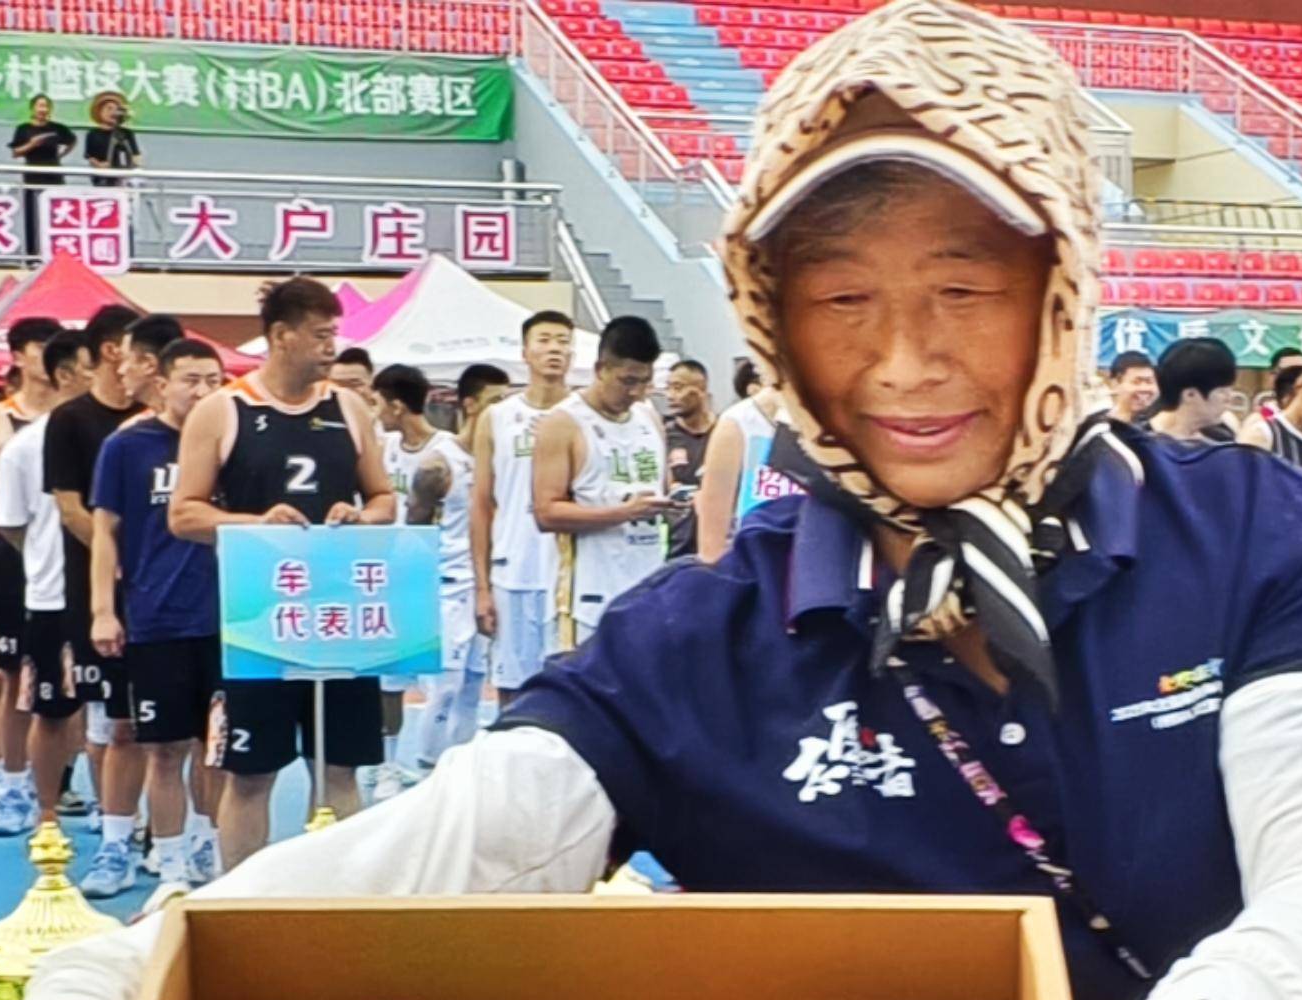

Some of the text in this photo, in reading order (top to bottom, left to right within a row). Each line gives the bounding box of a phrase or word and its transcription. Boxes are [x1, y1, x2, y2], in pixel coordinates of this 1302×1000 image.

[169, 194, 515, 267] 大户庄园
[285, 457, 318, 492] 2
[274, 561, 388, 594] 牟平
[273, 605, 394, 640] 代表队
[73, 665, 101, 684] 10
[138, 700, 157, 723] 5
[231, 728, 252, 753] 2
